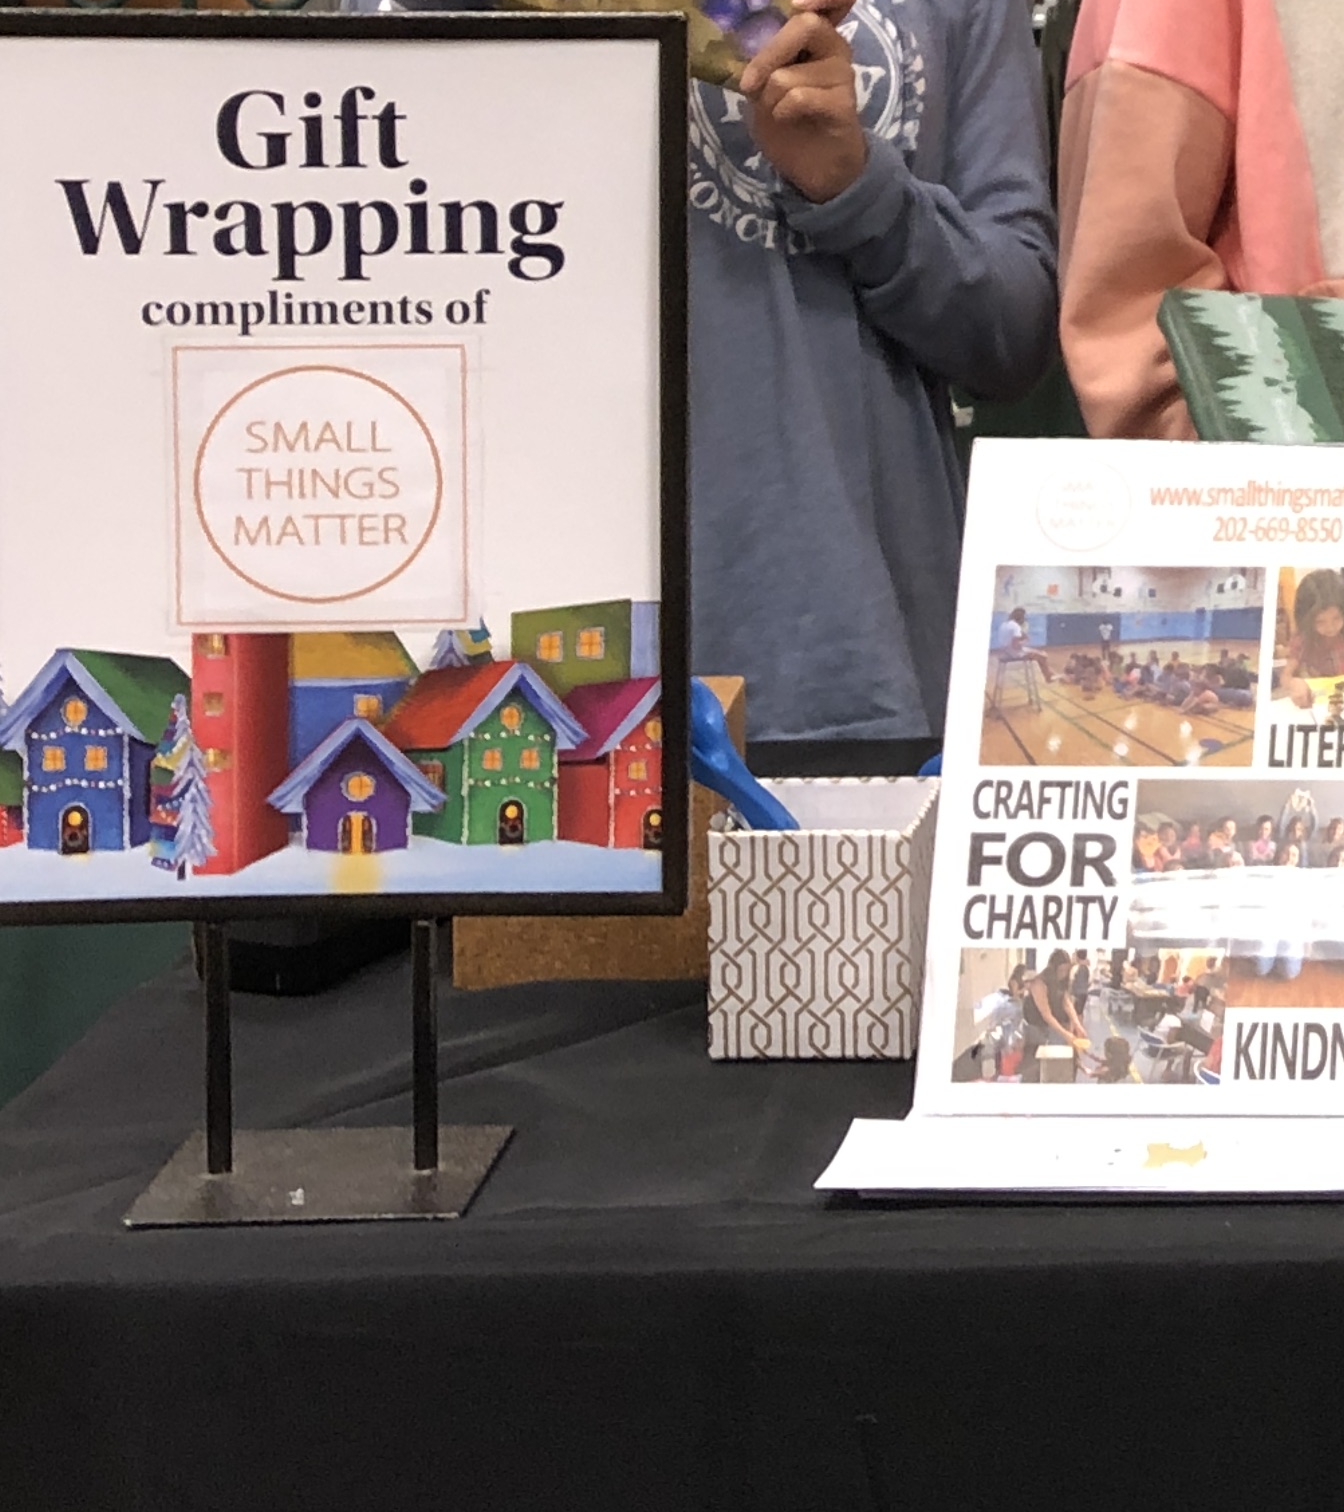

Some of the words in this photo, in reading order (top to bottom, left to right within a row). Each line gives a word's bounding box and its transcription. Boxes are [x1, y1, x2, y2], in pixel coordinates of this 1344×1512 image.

[215, 86, 409, 171] Gift
[56, 178, 565, 282] Wrapping
[141, 291, 433, 336] compliments
[445, 290, 492, 326] of
[245, 420, 392, 454] SMALL
[236, 466, 401, 500] THINGS
[233, 513, 409, 547] MATTER
[1212, 516, 1343, 543] 202-669-8550
[972, 780, 1129, 821] CRAFTING
[966, 830, 1118, 888] FOR
[963, 894, 1119, 941] CHARITY
